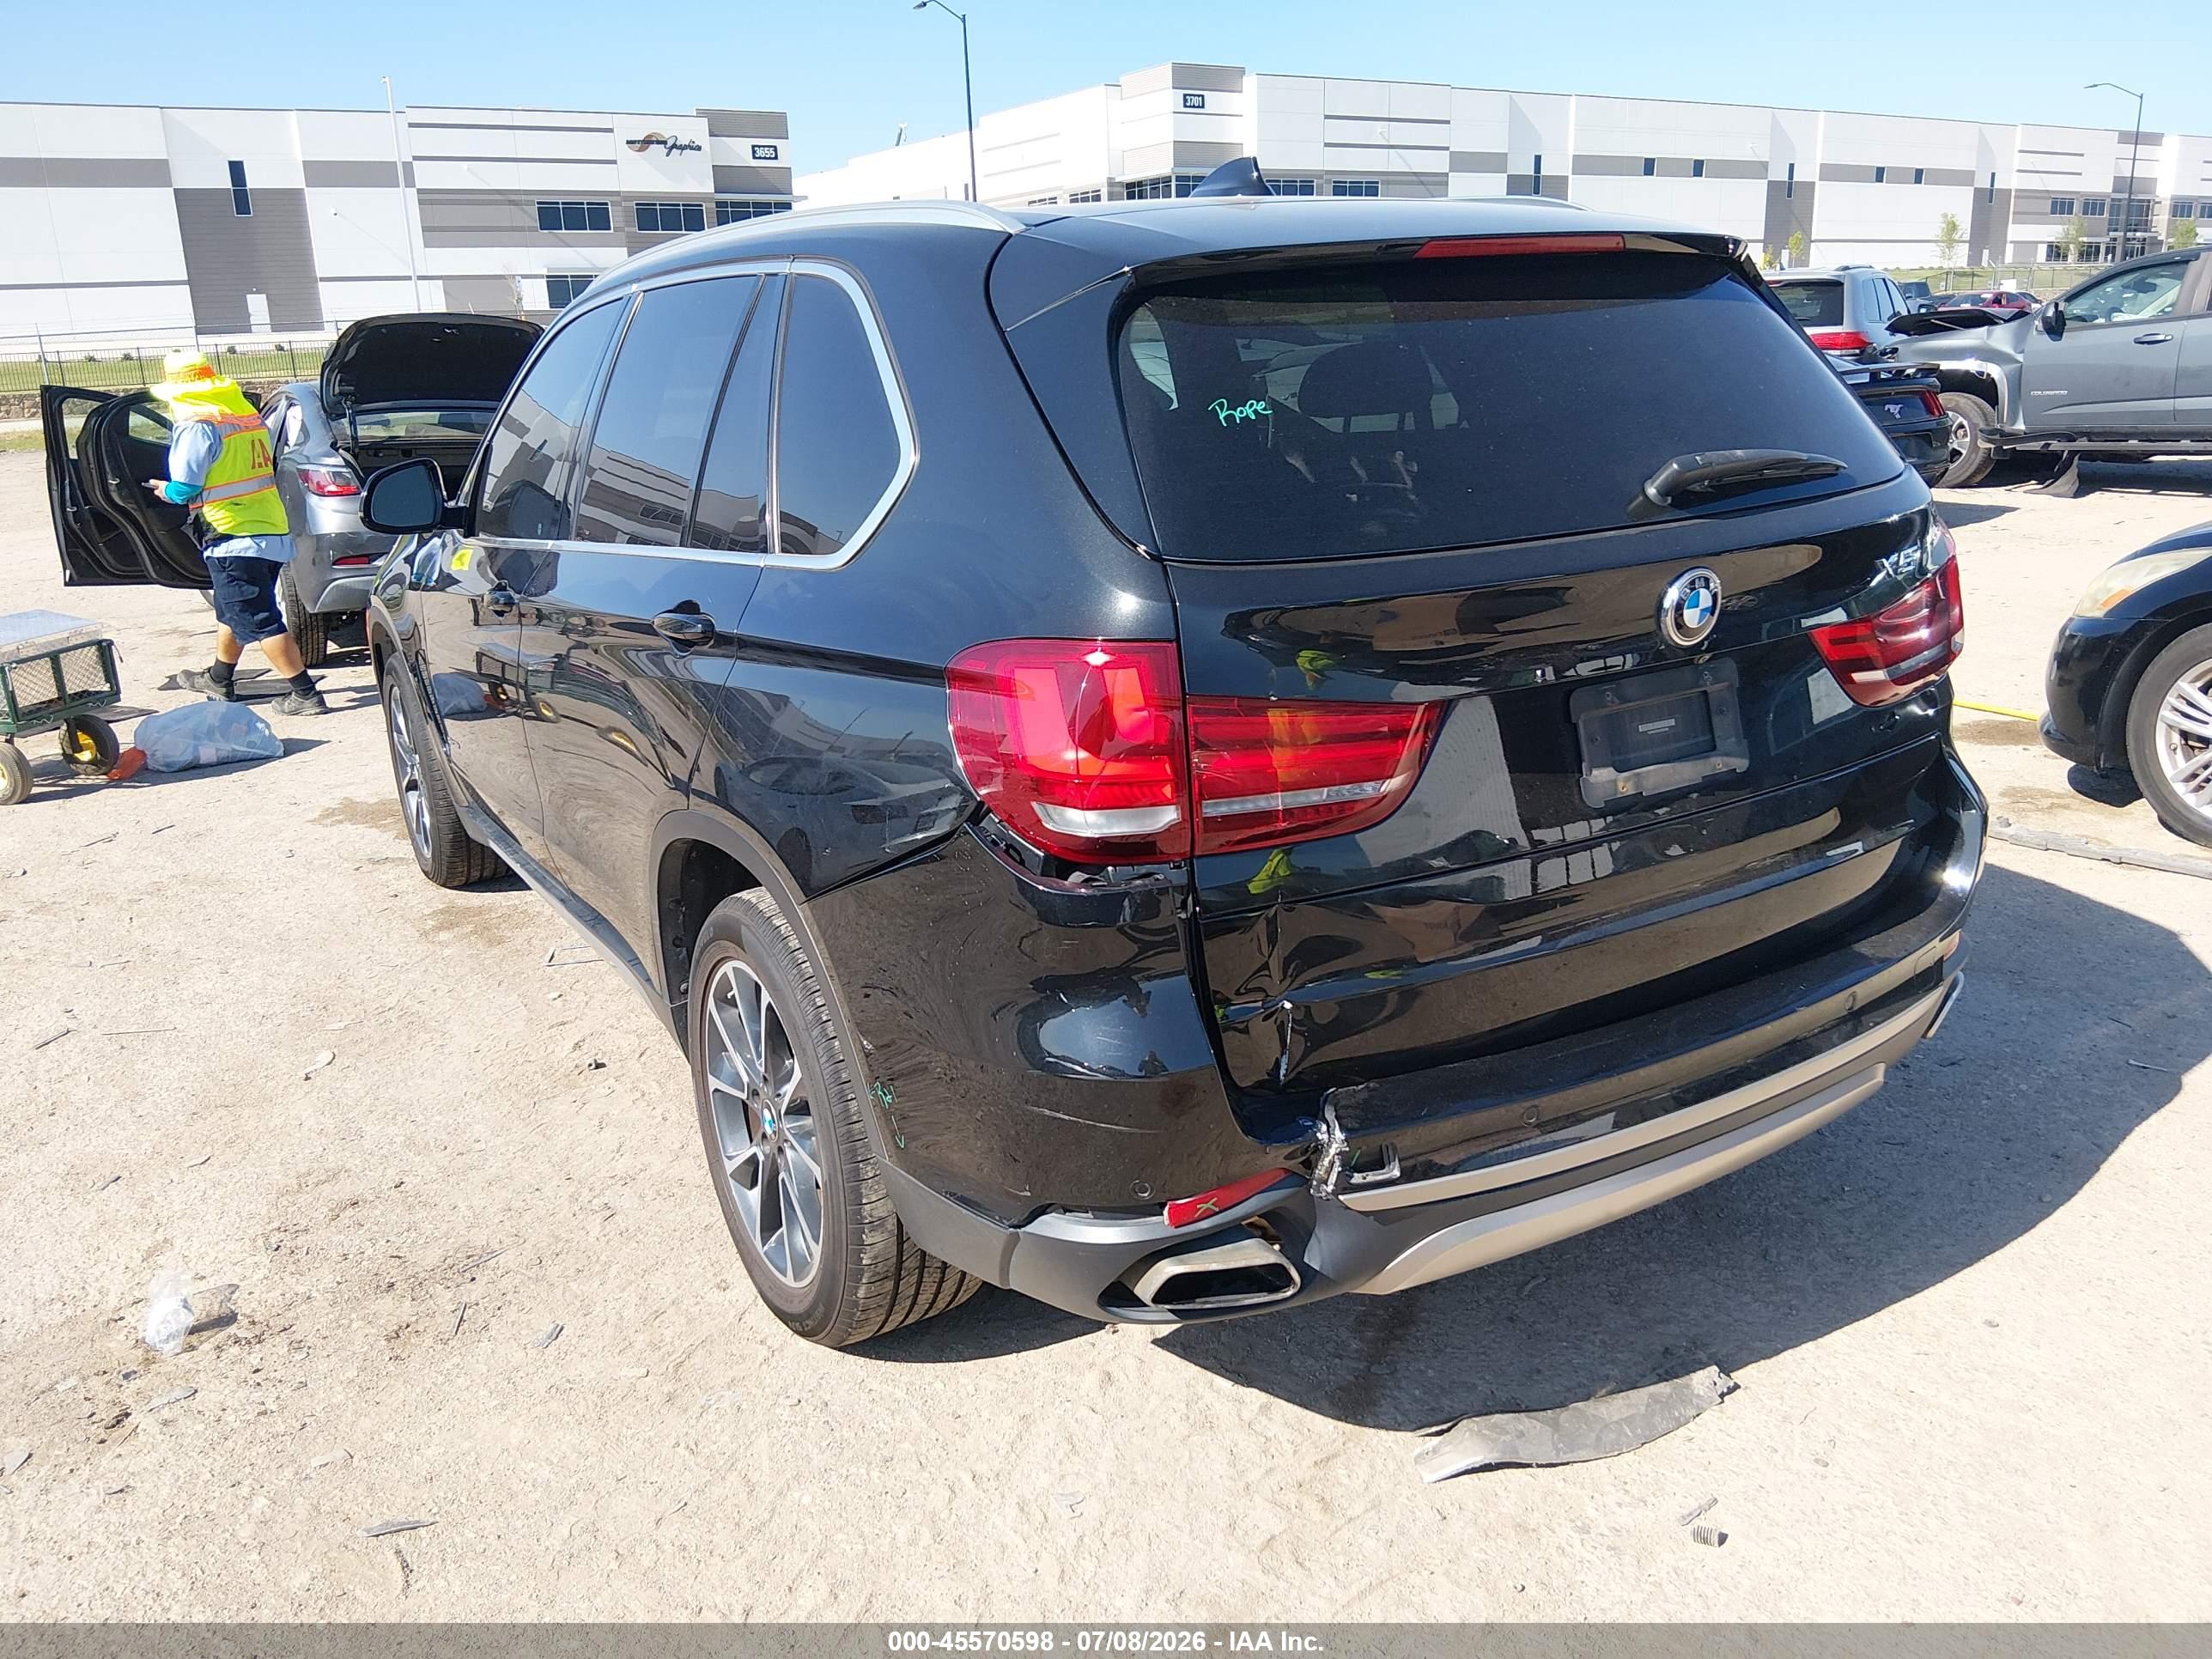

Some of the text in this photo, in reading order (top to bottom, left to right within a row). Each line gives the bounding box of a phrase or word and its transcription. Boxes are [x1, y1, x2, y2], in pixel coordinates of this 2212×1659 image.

[1186, 95, 1202, 106] 3701
[755, 147, 775, 158] 3655
[1207, 398, 1273, 427] Rope
